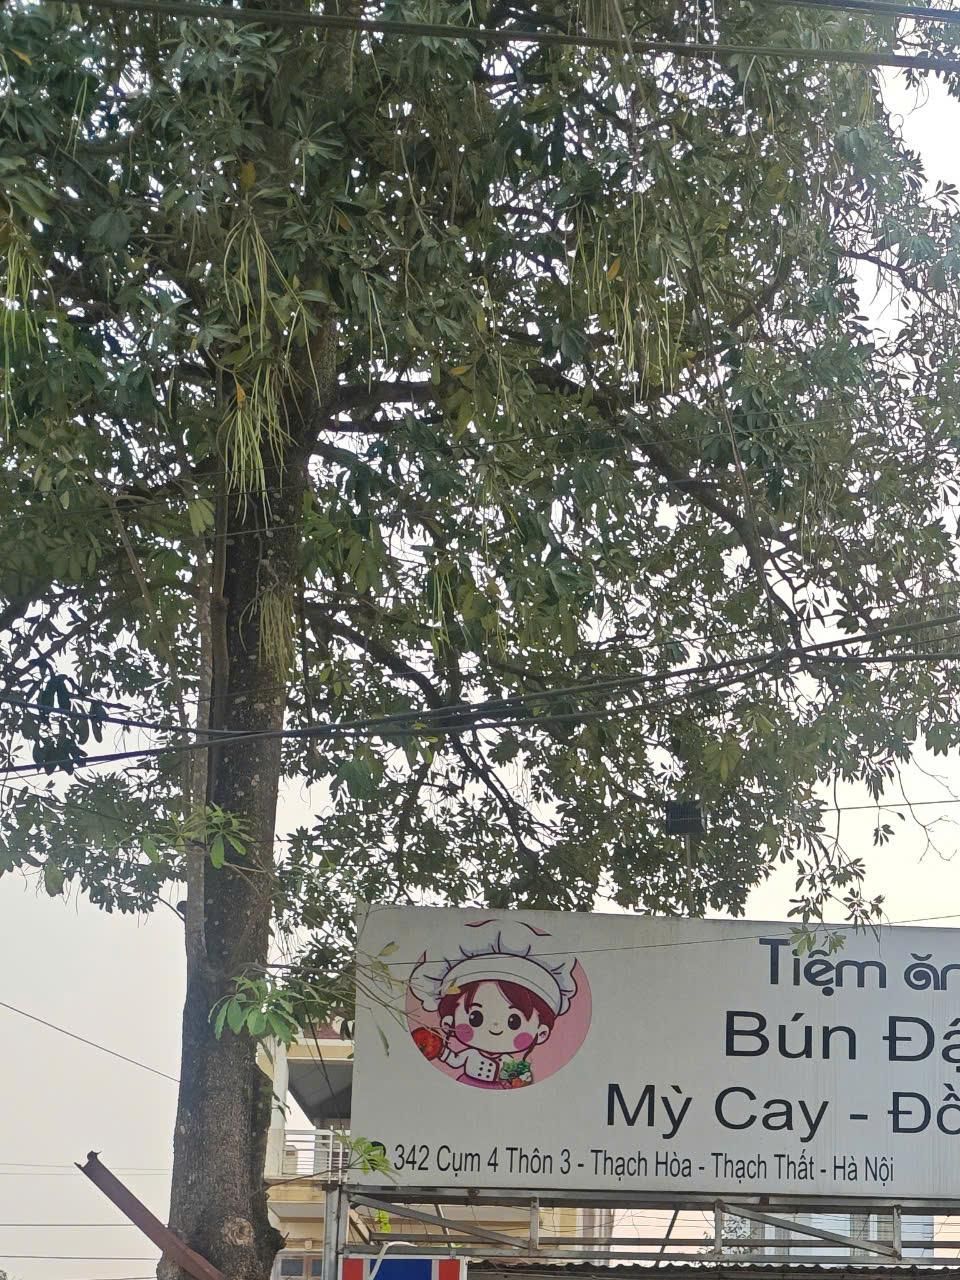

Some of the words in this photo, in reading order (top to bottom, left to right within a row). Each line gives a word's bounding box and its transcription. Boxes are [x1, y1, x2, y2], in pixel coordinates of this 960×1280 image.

[758, 938, 887, 996] Tiệm
[725, 1010, 857, 1060] Bún
[606, 1083, 693, 1140] Mỳ
[714, 1086, 830, 1143] Cay
[849, 1113, 869, 1121] -
[393, 1144, 430, 1171] 342
[436, 1145, 481, 1178] Cụm
[487, 1147, 499, 1173] 4
[505, 1147, 553, 1175] Thôn
[560, 1148, 571, 1175] 3
[590, 1149, 648, 1182] Thạch
[655, 1151, 692, 1178] Hòa
[710, 1152, 767, 1184] Thạch
[773, 1149, 815, 1180] Thất
[833, 1155, 858, 1182] Hà
[865, 1156, 895, 1186] Nội
